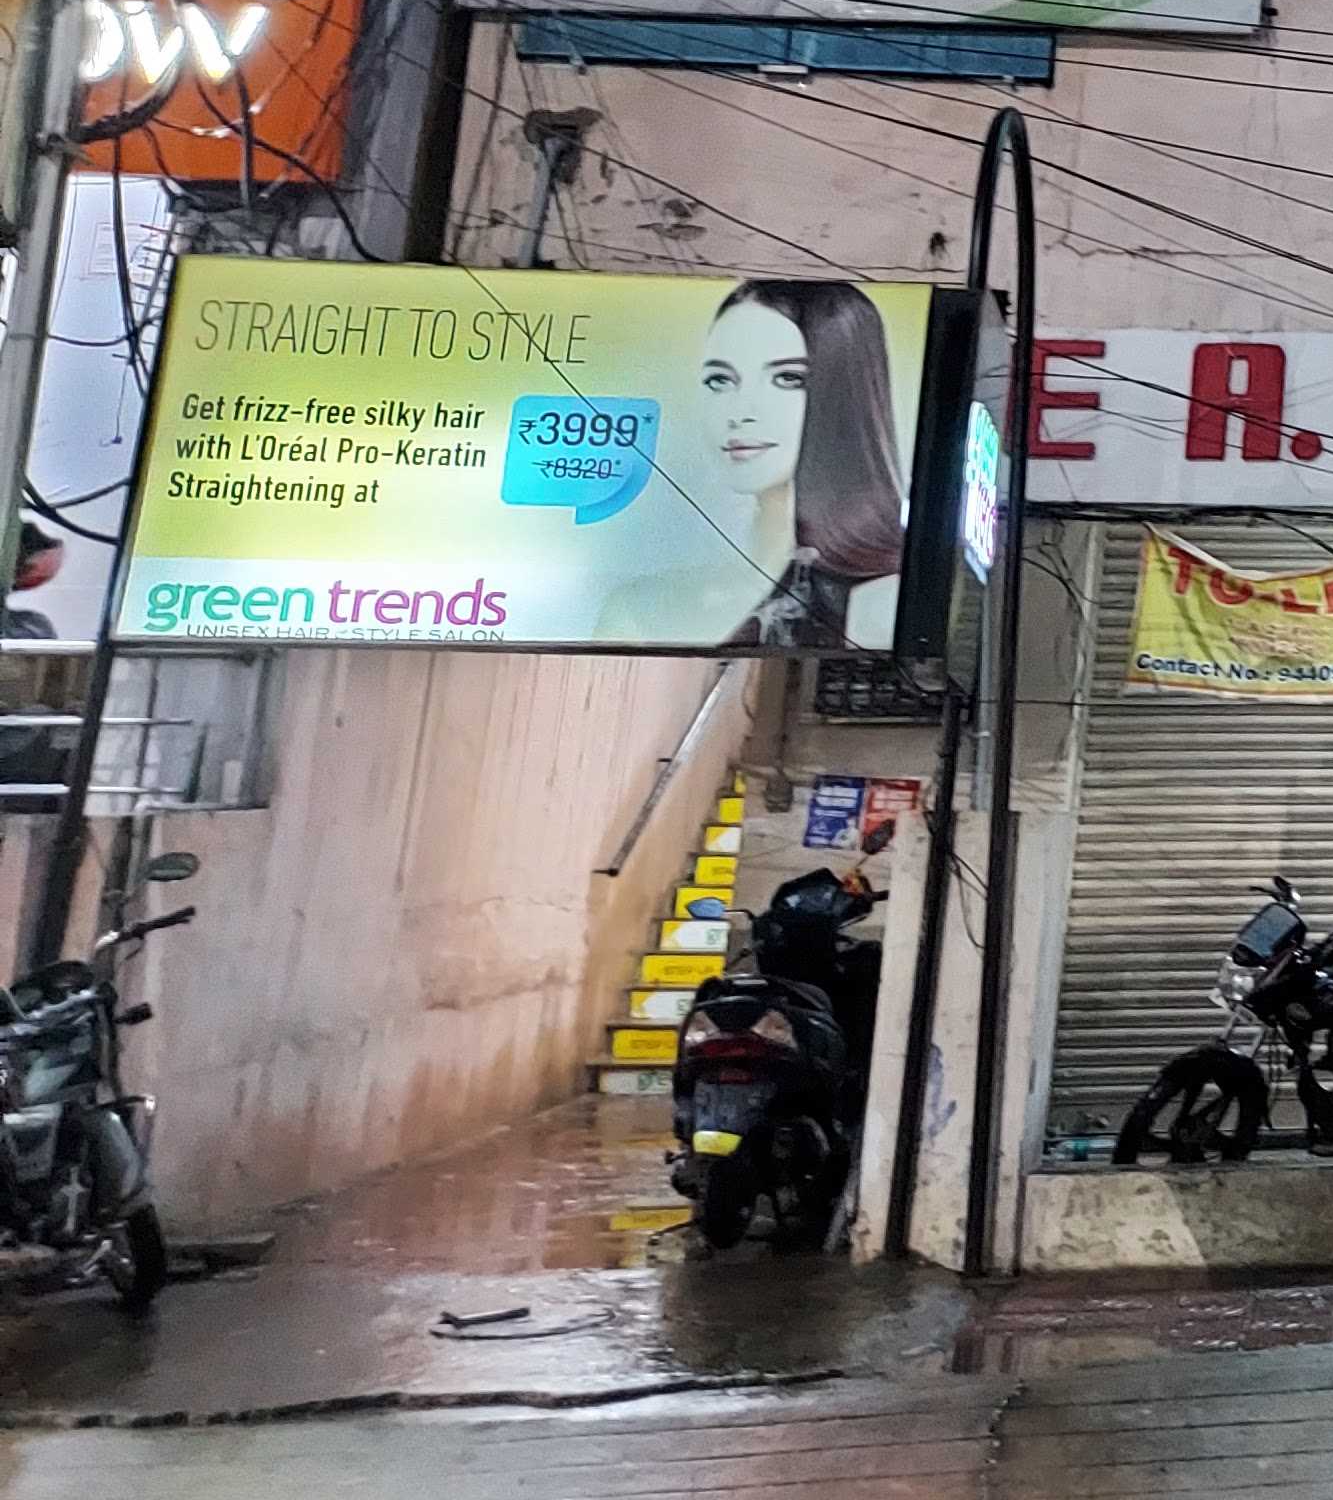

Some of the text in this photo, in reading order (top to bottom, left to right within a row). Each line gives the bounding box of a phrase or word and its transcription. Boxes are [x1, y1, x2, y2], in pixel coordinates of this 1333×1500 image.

[195, 300, 591, 365] STRAIGHT TO STYLE
[182, 393, 486, 434] Get frizz-free silky hair
[176, 435, 487, 468] with L'Oréal Pro-Keratin
[169, 472, 380, 508] Straightening at
[145, 578, 507, 632] green trends
[1136, 653, 1222, 677] Contact
